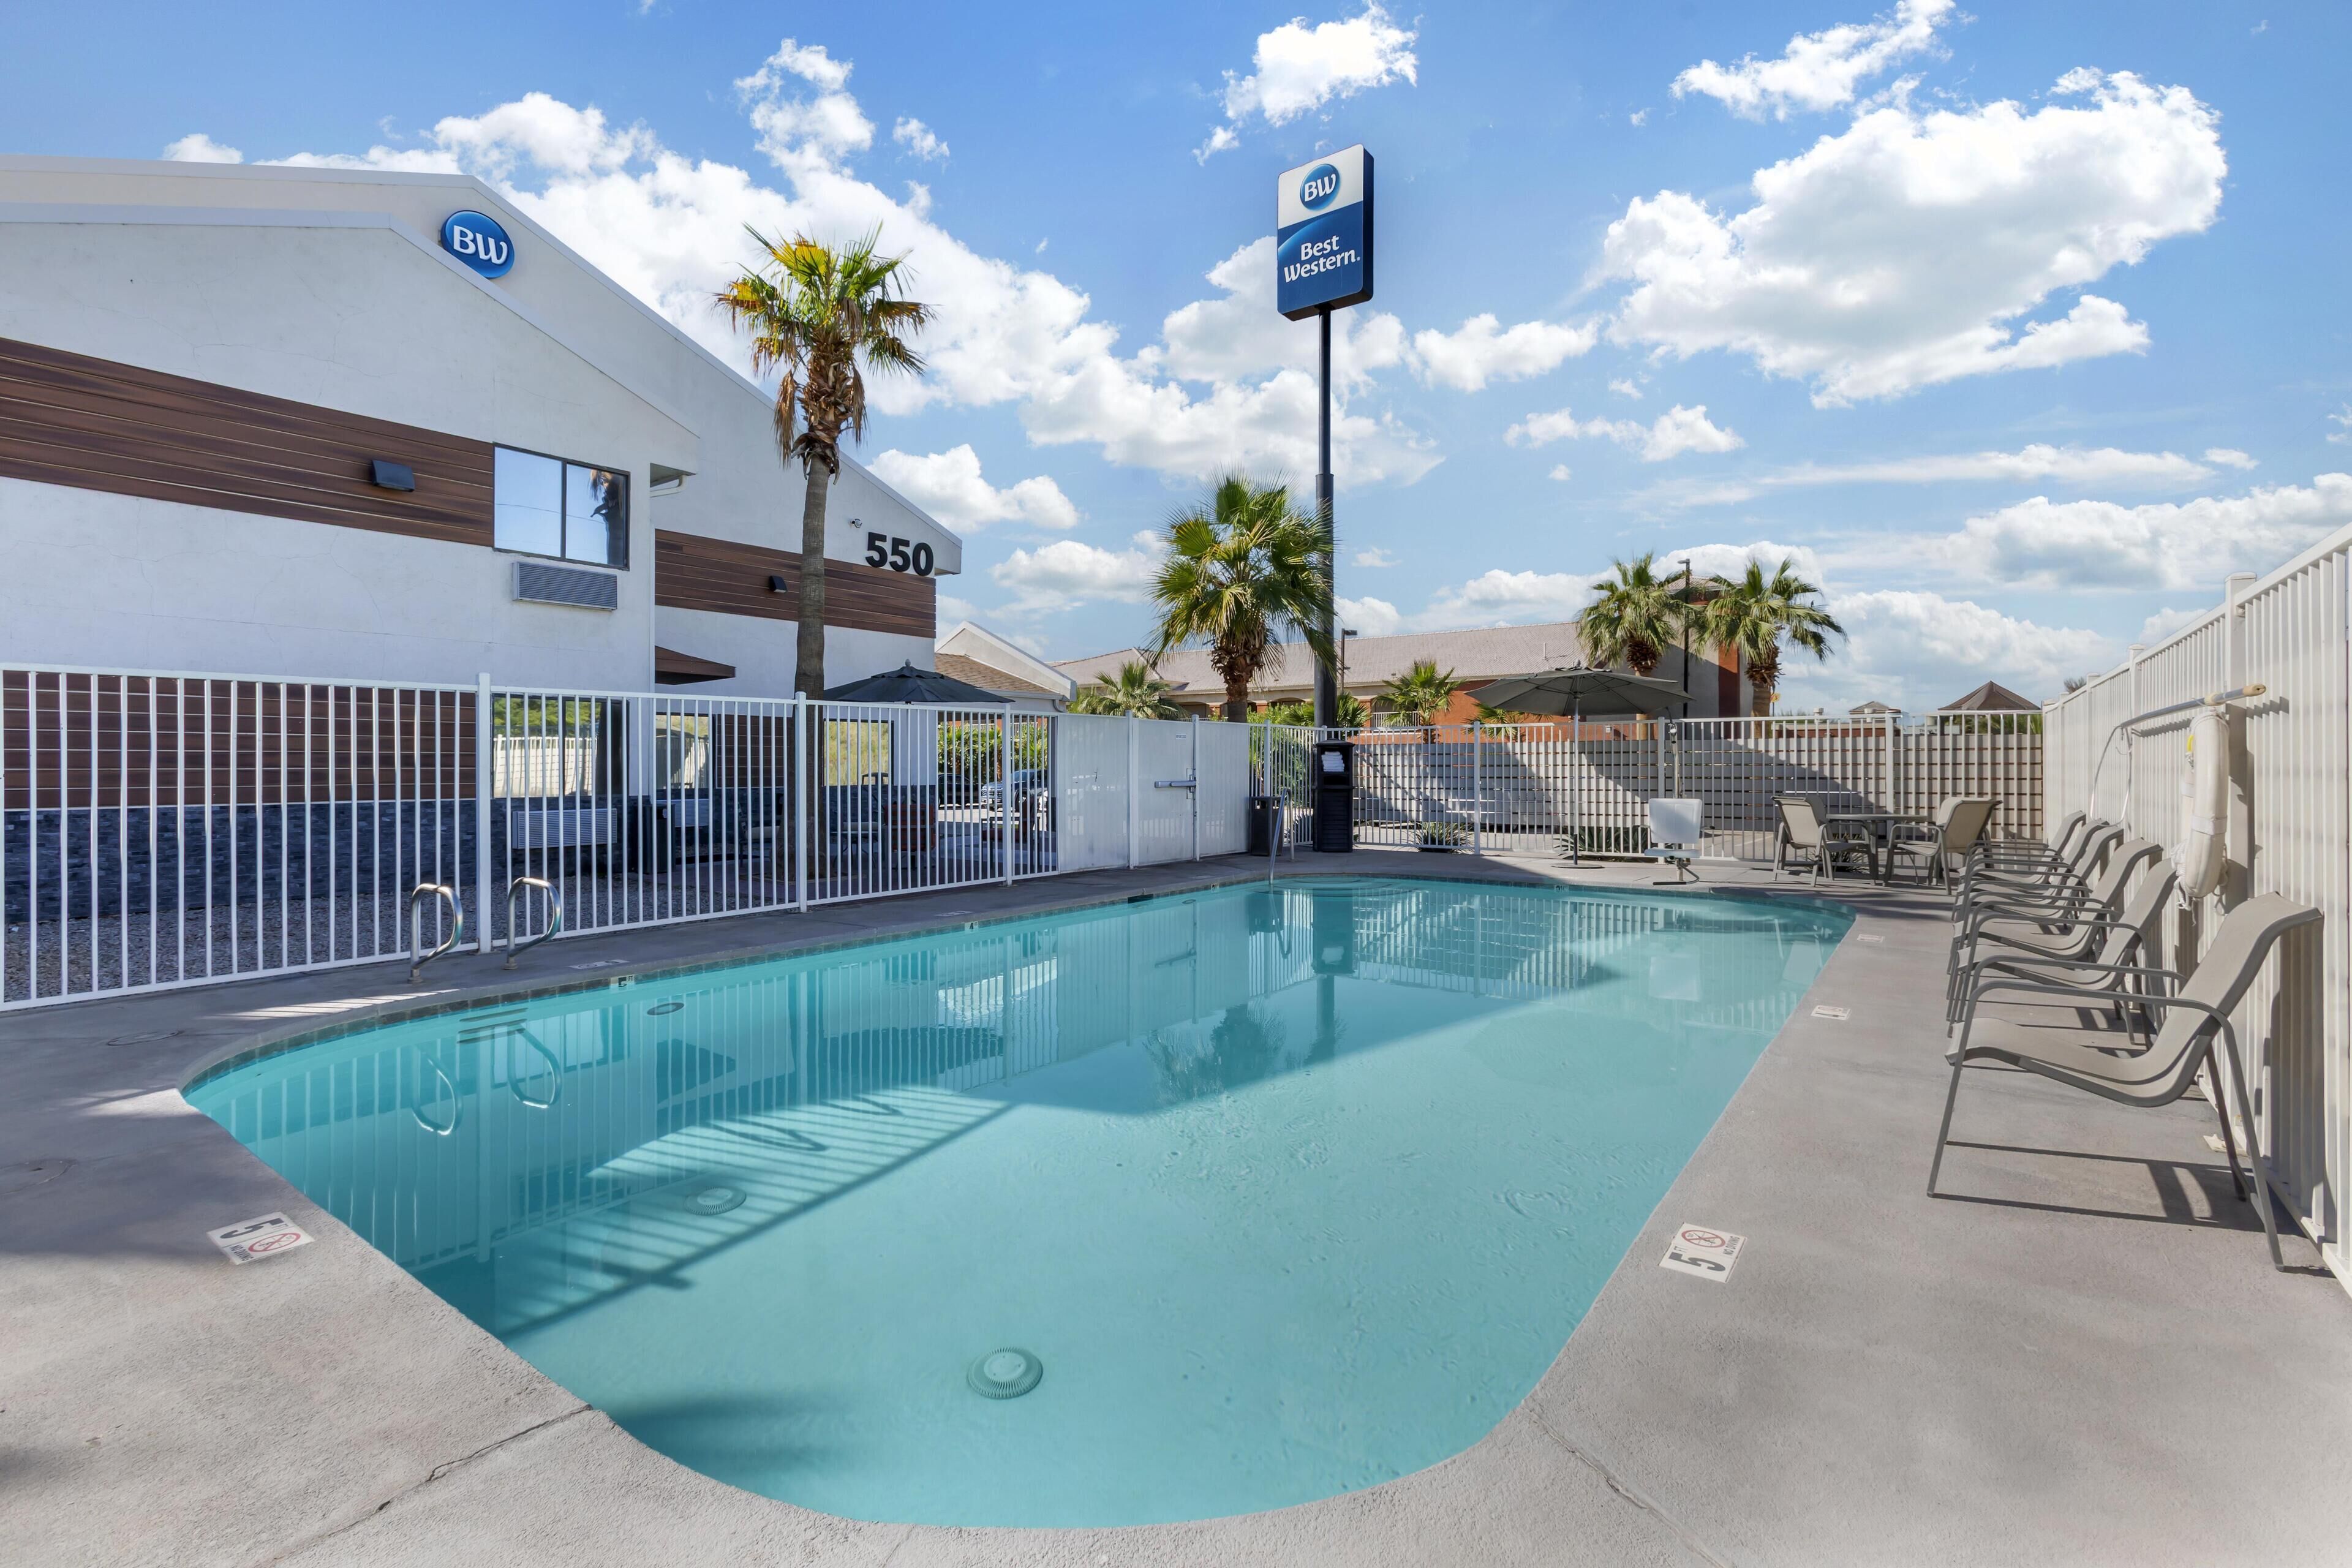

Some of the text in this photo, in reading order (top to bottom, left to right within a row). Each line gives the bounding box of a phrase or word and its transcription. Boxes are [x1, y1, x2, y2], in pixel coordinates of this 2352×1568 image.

[1304, 173, 1336, 202] BW
[453, 225, 508, 265] BW
[1300, 235, 1340, 261] Best
[865, 532, 933, 576] 550
[220, 1218, 284, 1239] 5
[1668, 1251, 1726, 1272] 5
